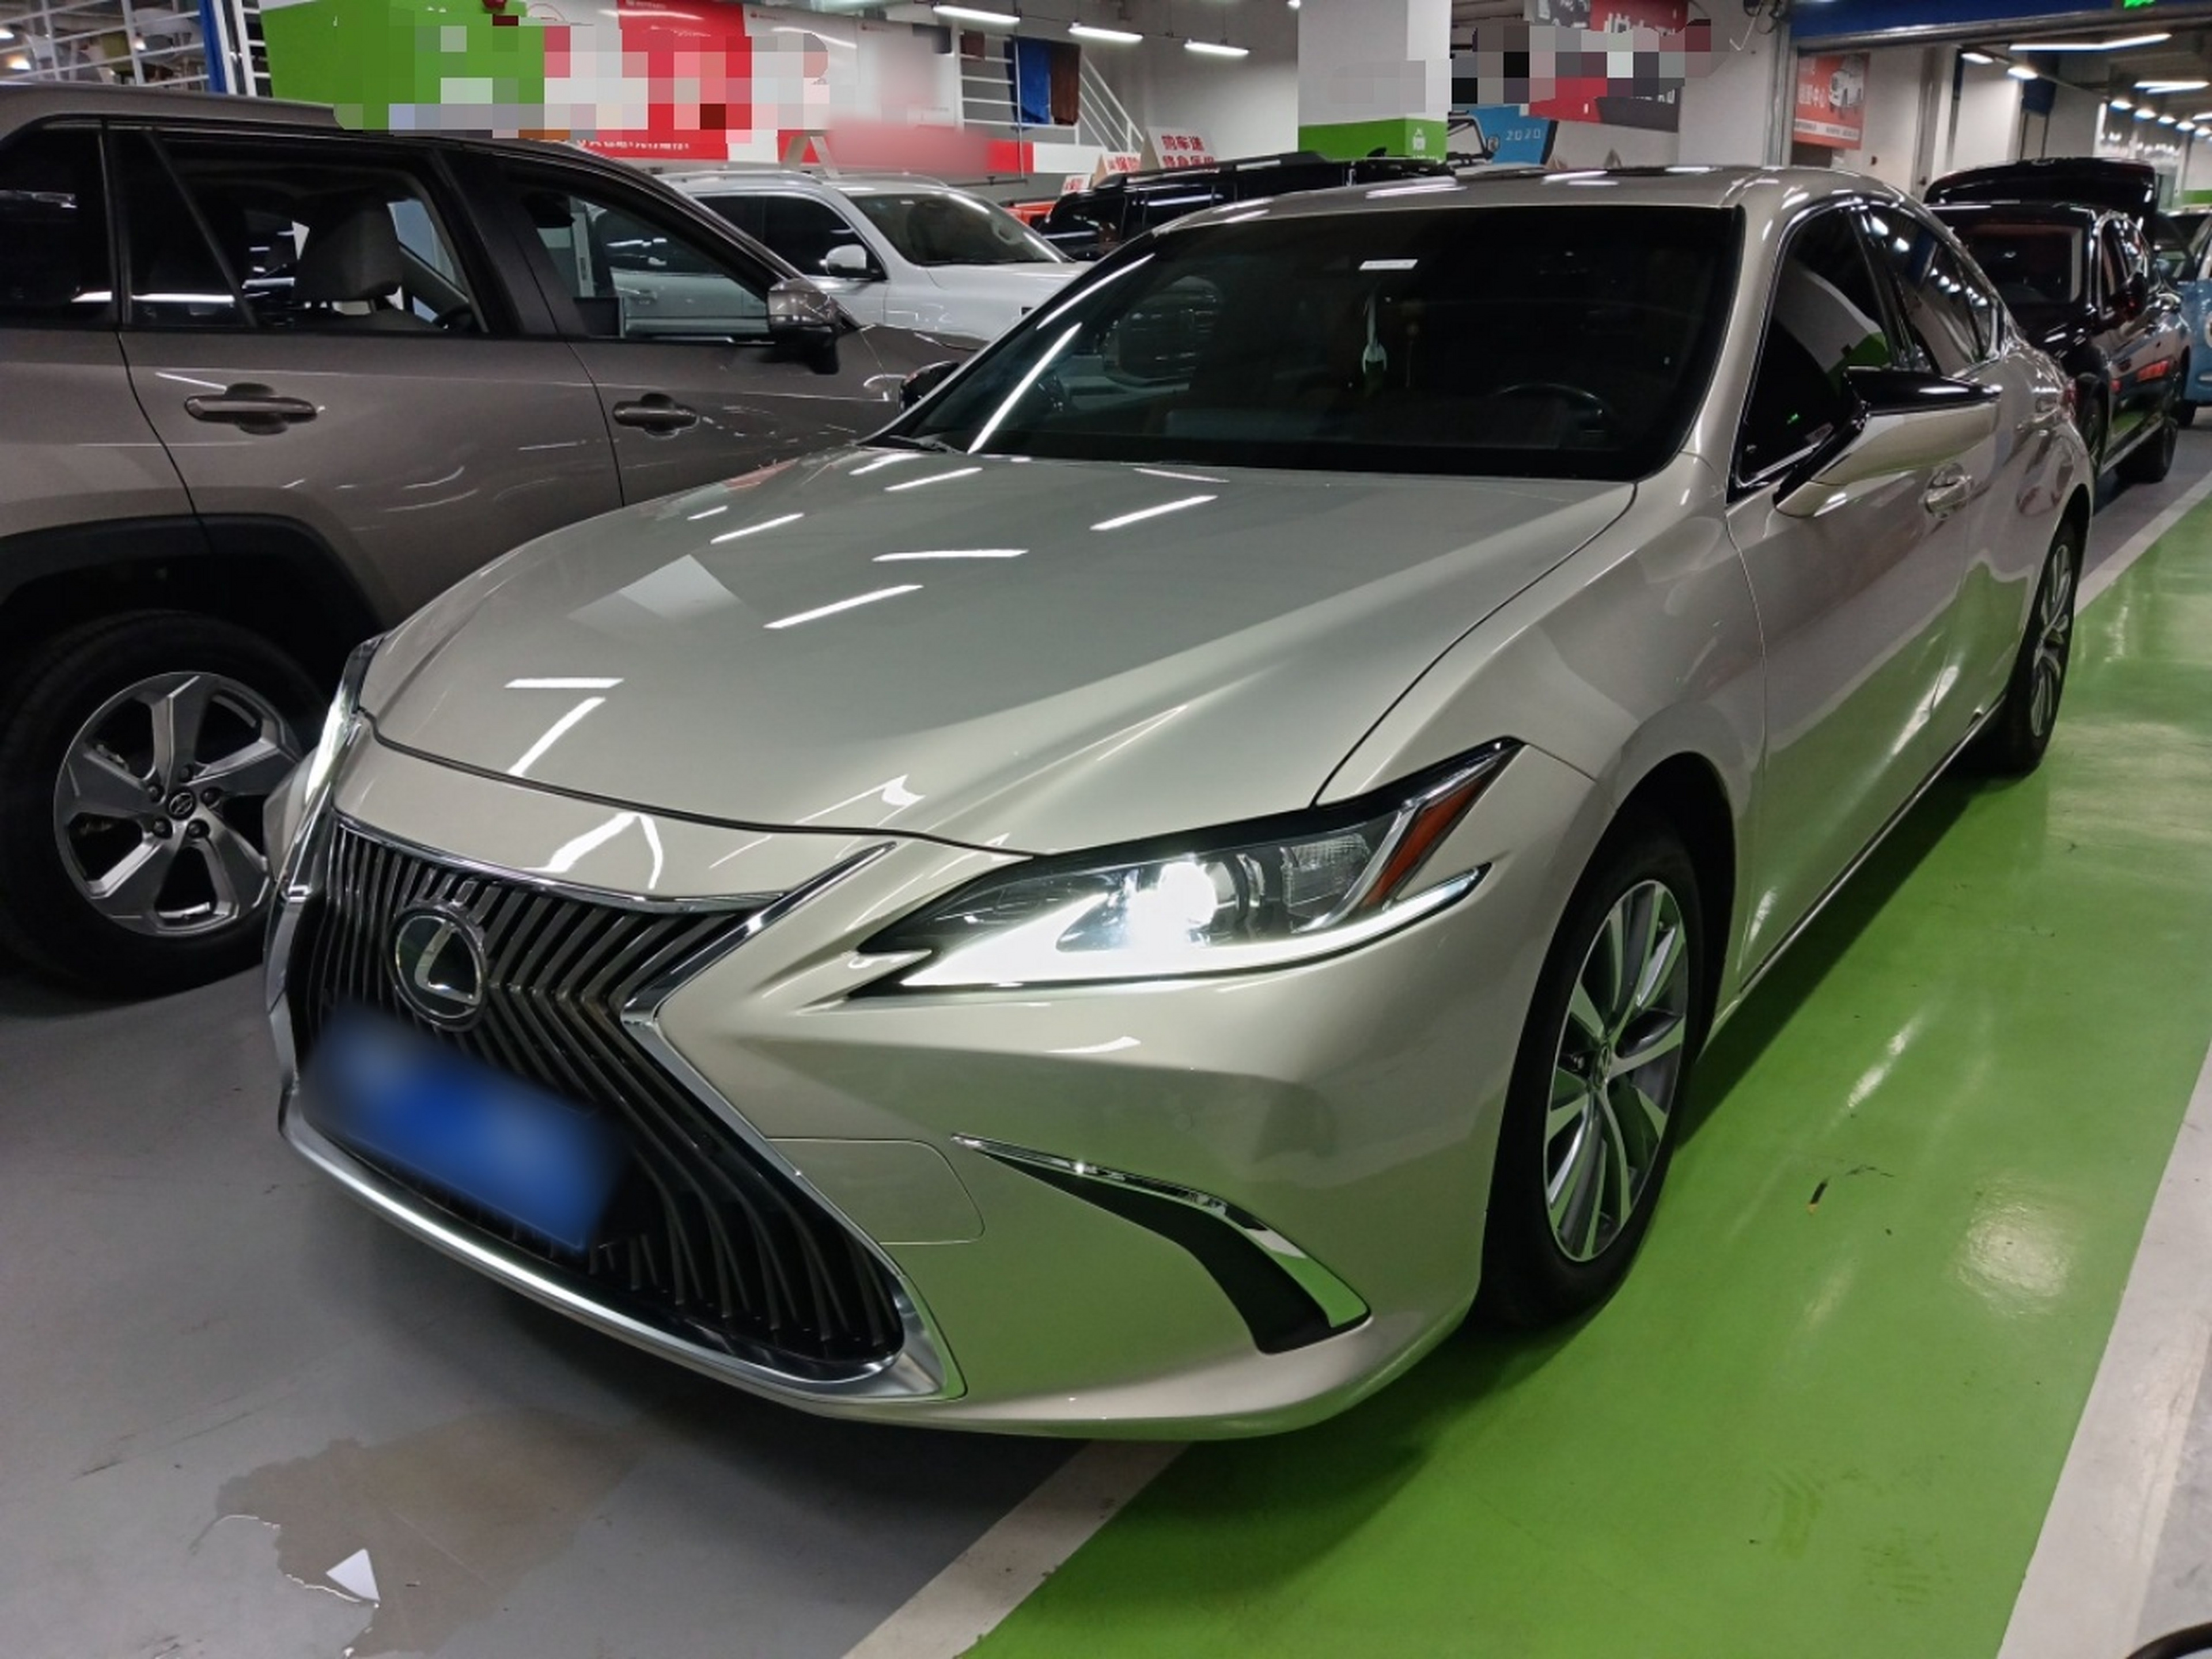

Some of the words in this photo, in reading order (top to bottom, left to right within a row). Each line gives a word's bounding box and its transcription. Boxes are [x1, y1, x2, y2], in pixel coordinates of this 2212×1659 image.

[1506, 128, 1541, 141] 2020
[1161, 134, 1205, 151] 购车送
